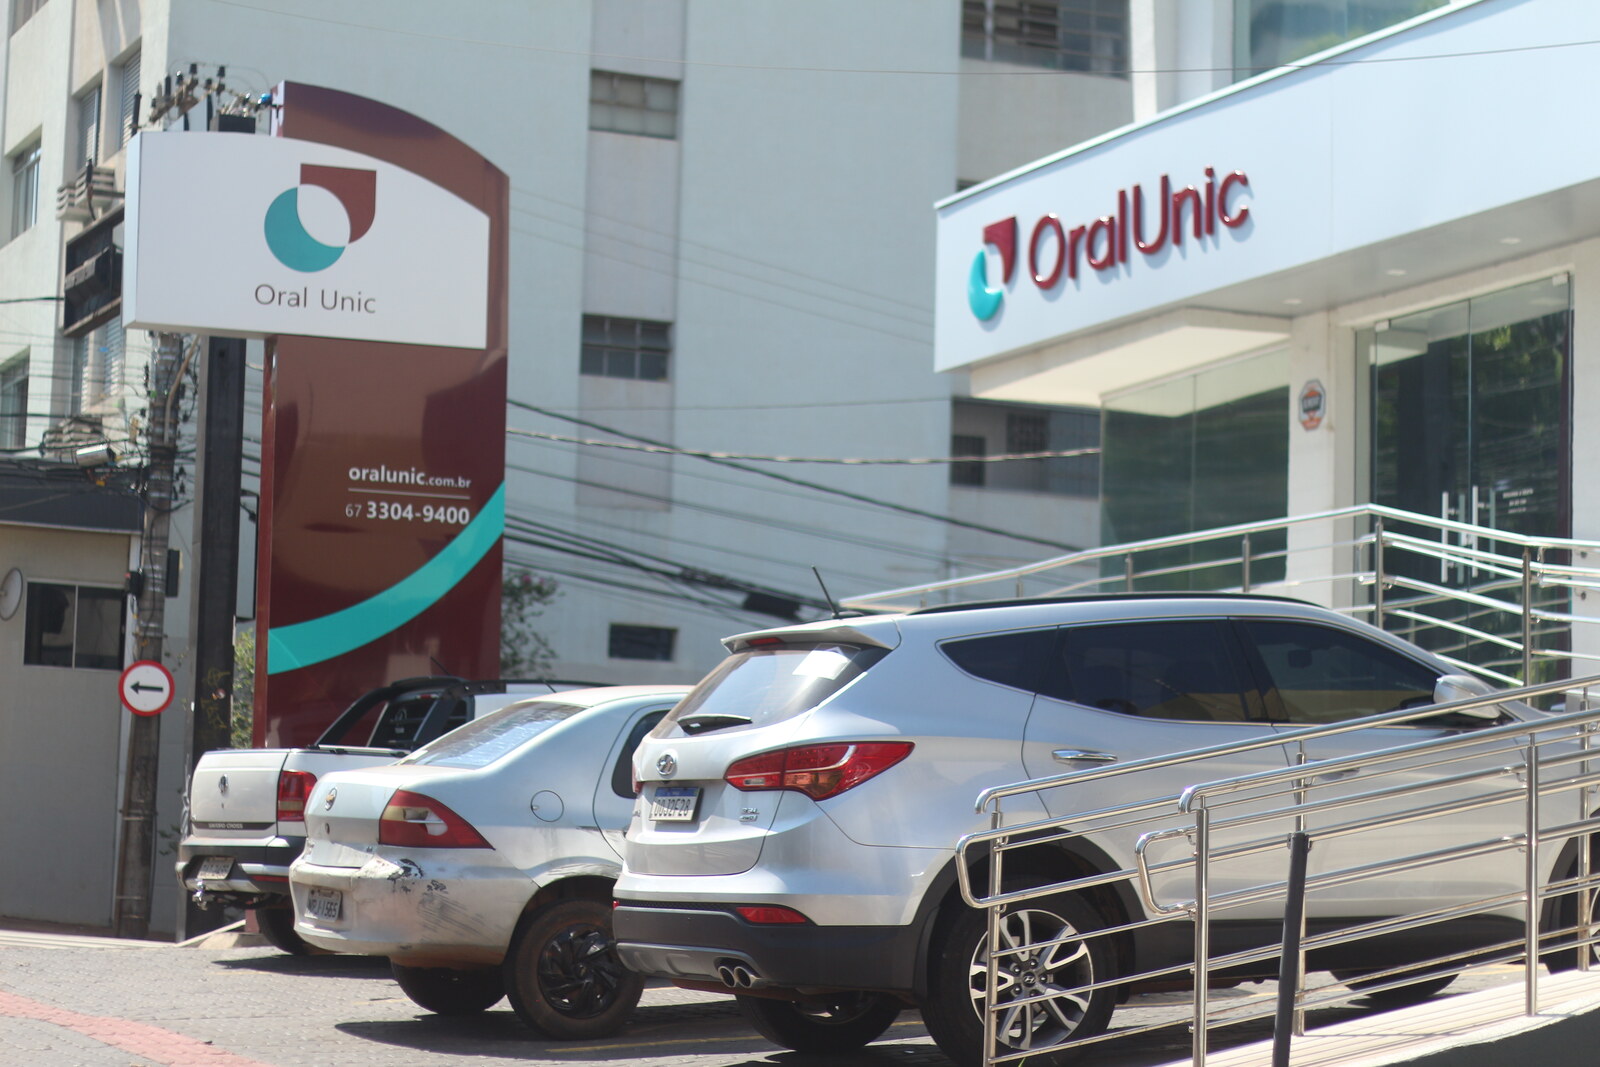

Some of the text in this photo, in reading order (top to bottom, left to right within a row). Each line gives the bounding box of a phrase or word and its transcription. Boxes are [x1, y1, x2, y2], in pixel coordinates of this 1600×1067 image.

[254, 283, 377, 314] Oral Unic
[348, 465, 472, 489] oralunic.com.br
[345, 501, 470, 525] 67 3304-9400
